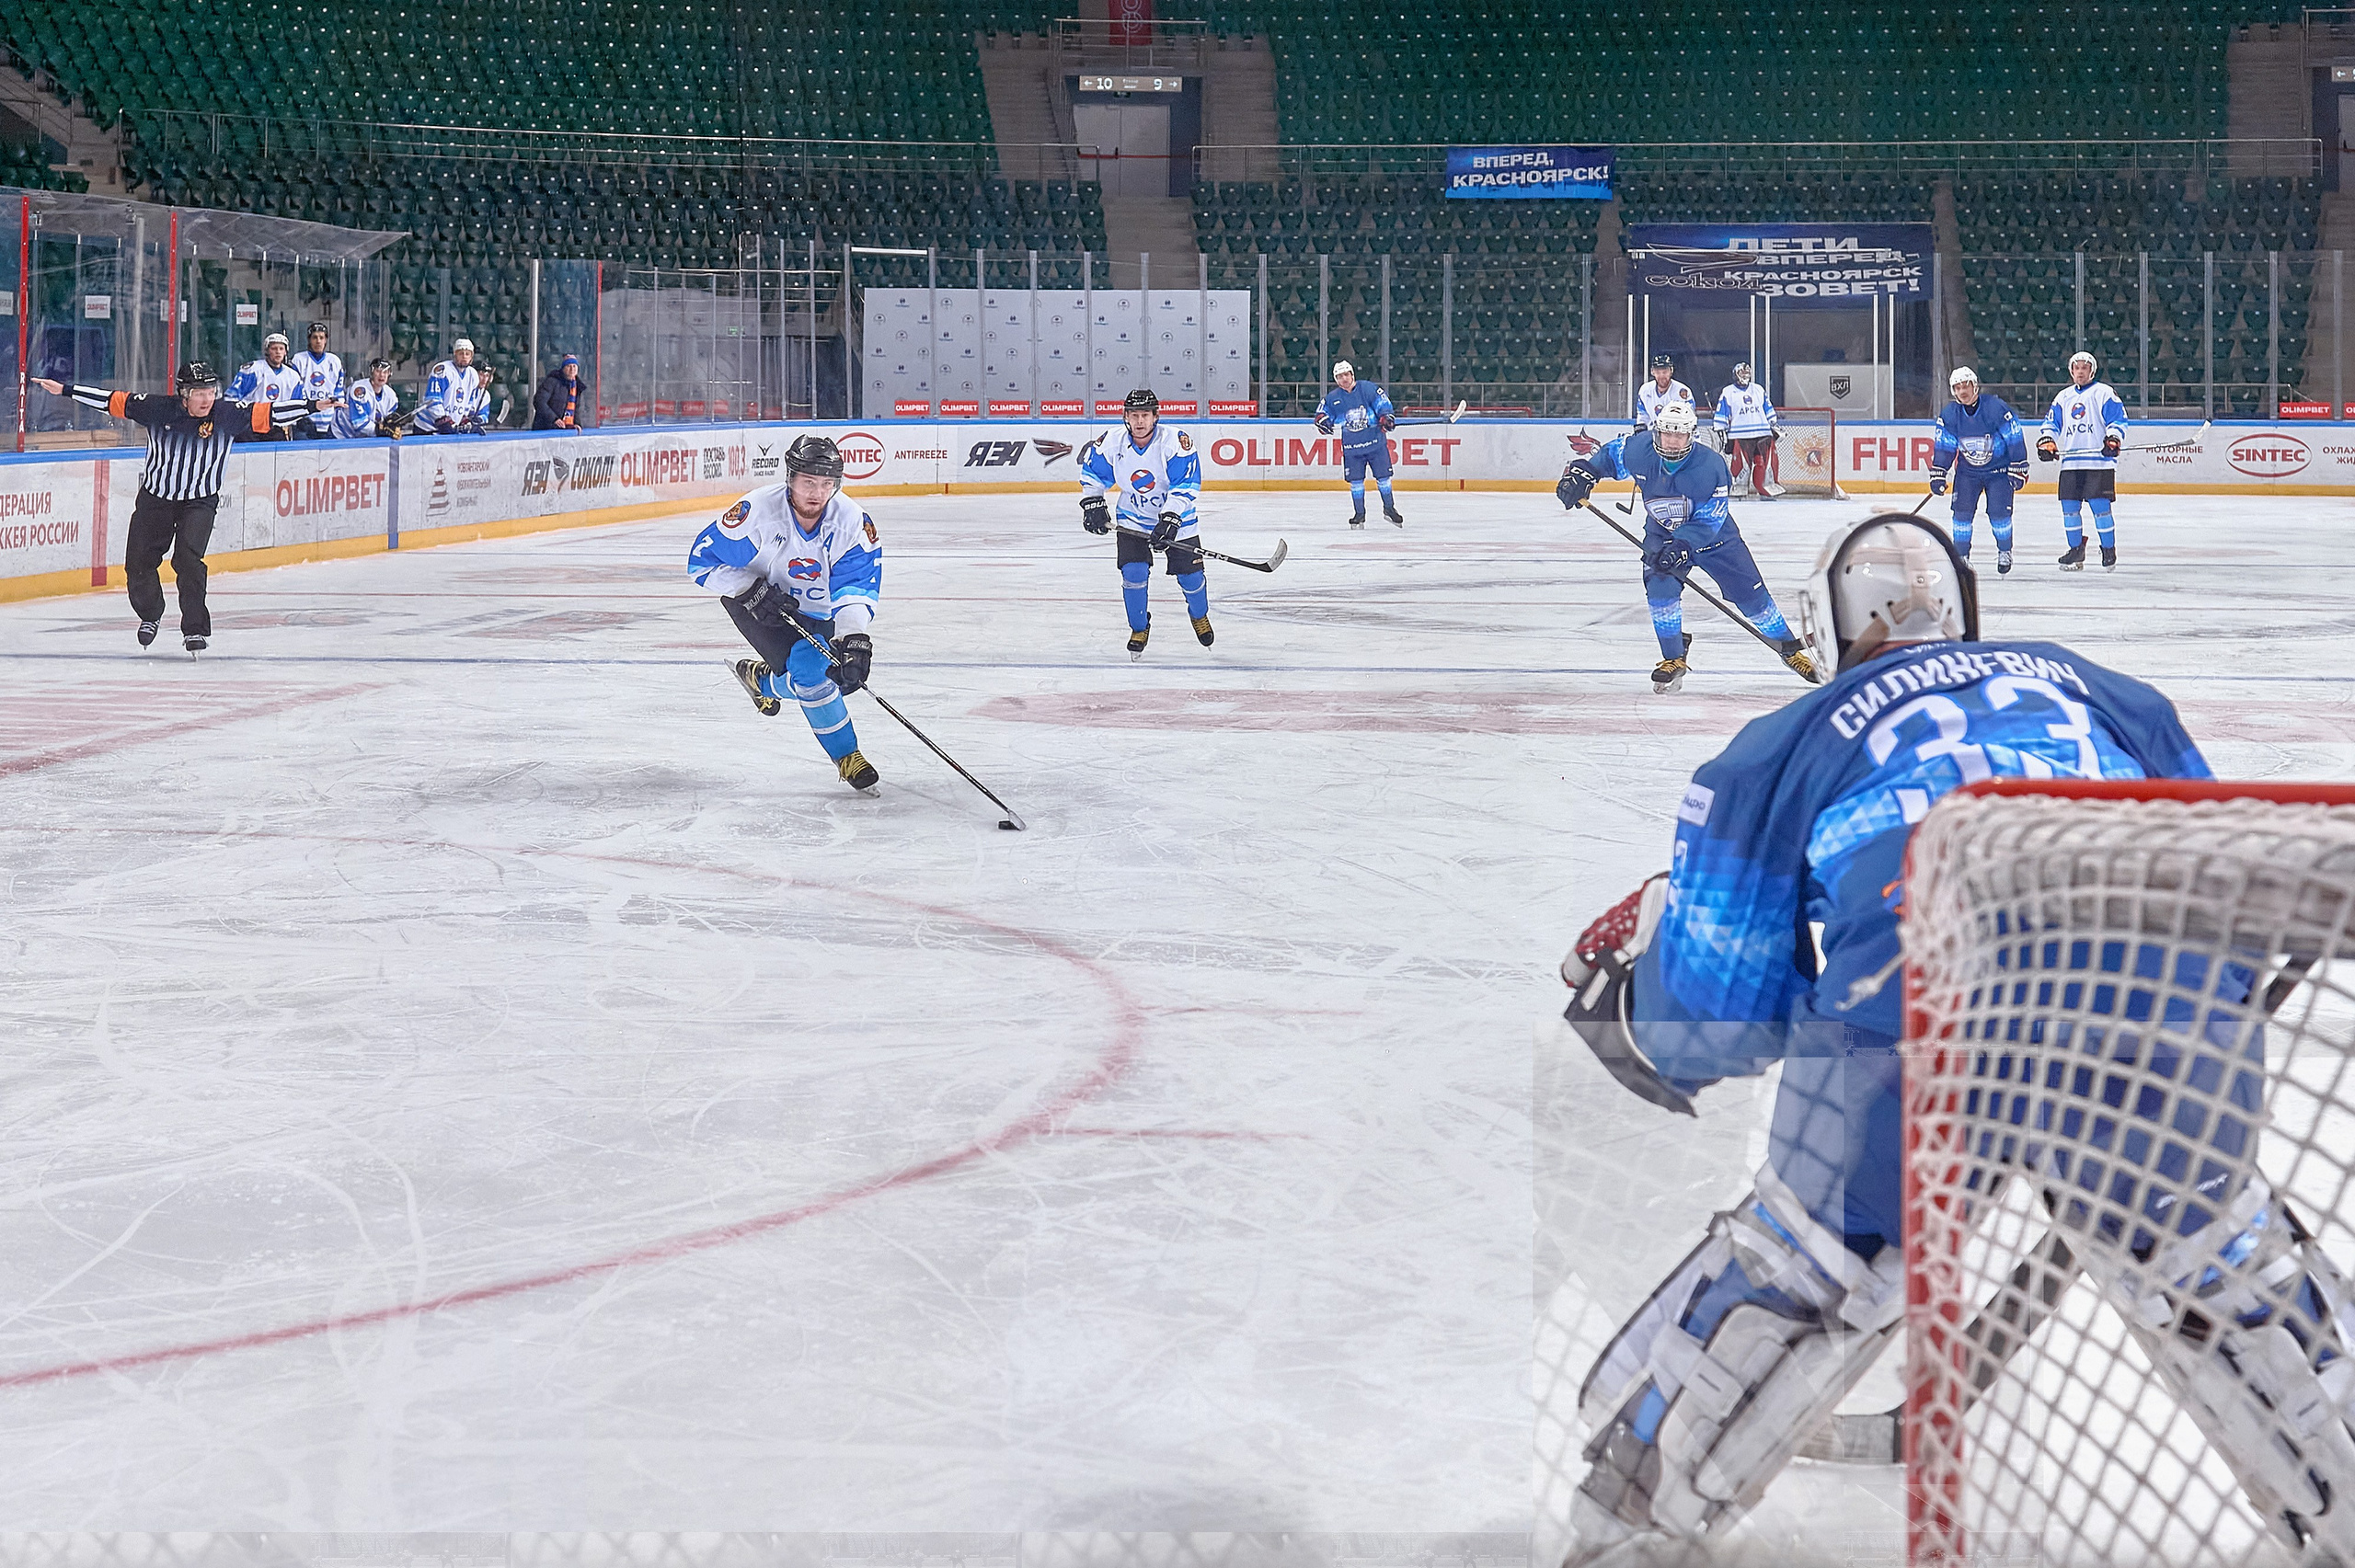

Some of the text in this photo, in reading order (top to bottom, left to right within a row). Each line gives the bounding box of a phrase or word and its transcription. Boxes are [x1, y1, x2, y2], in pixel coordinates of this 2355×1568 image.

[1096, 77, 1113, 90] 10
[1153, 78, 1163, 91] 9
[1473, 152, 1555, 168] ВПЕРЕД,
[1453, 166, 1609, 188] КРАСНОЯРСК!
[1725, 237, 1858, 253] ЛЕТИ
[1724, 266, 1924, 280] КРАСНОЯРСК
[1755, 278, 1921, 297] ЗОВЕТ!
[1158, 404, 1196, 412] LIMPBET
[1739, 407, 1760, 416] АРСК
[894, 450, 948, 460] ANTIFREEZE
[1210, 439, 1461, 466] OLIMET
[1853, 437, 1935, 471] FHR
[2156, 455, 2193, 464] МАСЛА
[2232, 448, 2305, 463] SINTEC
[620, 449, 698, 488] OLIMPBET
[751, 457, 780, 469] RECORD
[276, 473, 385, 518] OLIMPBET
[29, 521, 79, 547] РОССИИ
[692, 534, 715, 558] 7
